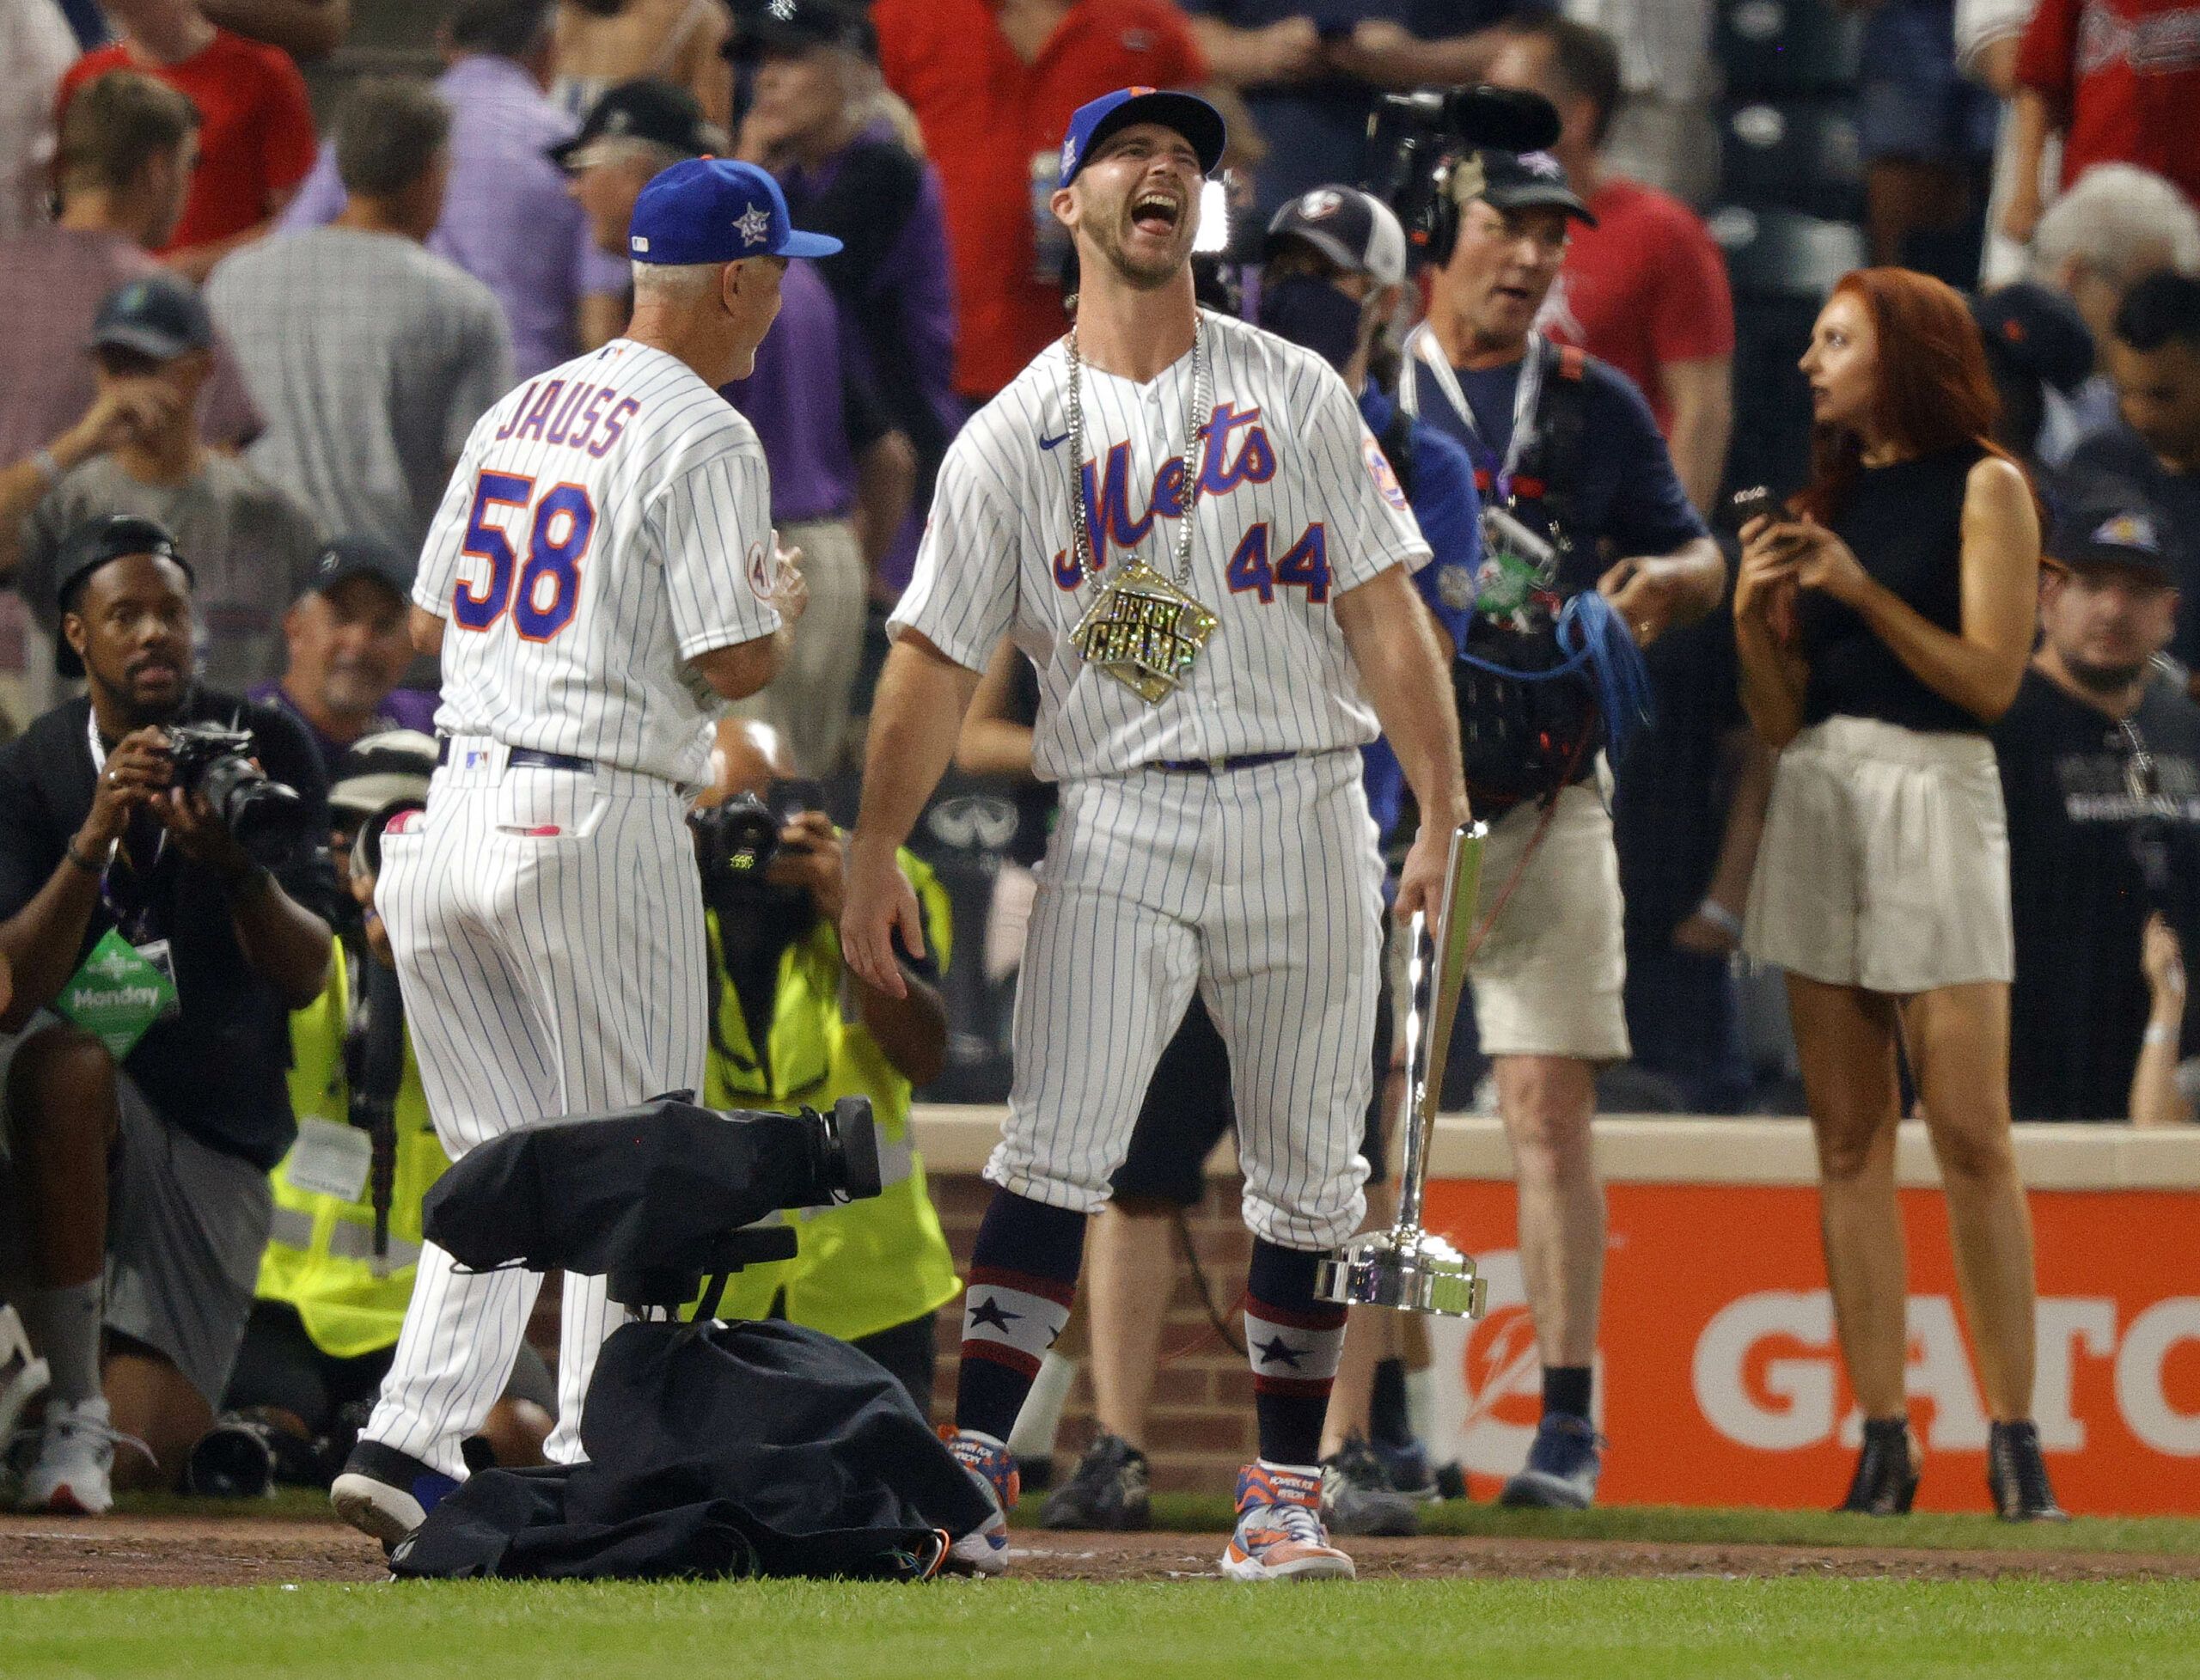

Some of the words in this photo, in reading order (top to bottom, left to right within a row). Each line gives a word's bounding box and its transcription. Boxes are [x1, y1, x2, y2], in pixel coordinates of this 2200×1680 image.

[496, 380, 641, 459] JAUSS
[1053, 403, 1276, 591] Mets
[451, 469, 596, 644] 58
[1225, 522, 1332, 604] 44
[1085, 620, 1195, 675] CHAMP
[1110, 590, 1184, 635] DERBY
[73, 986, 159, 1010] Monday
